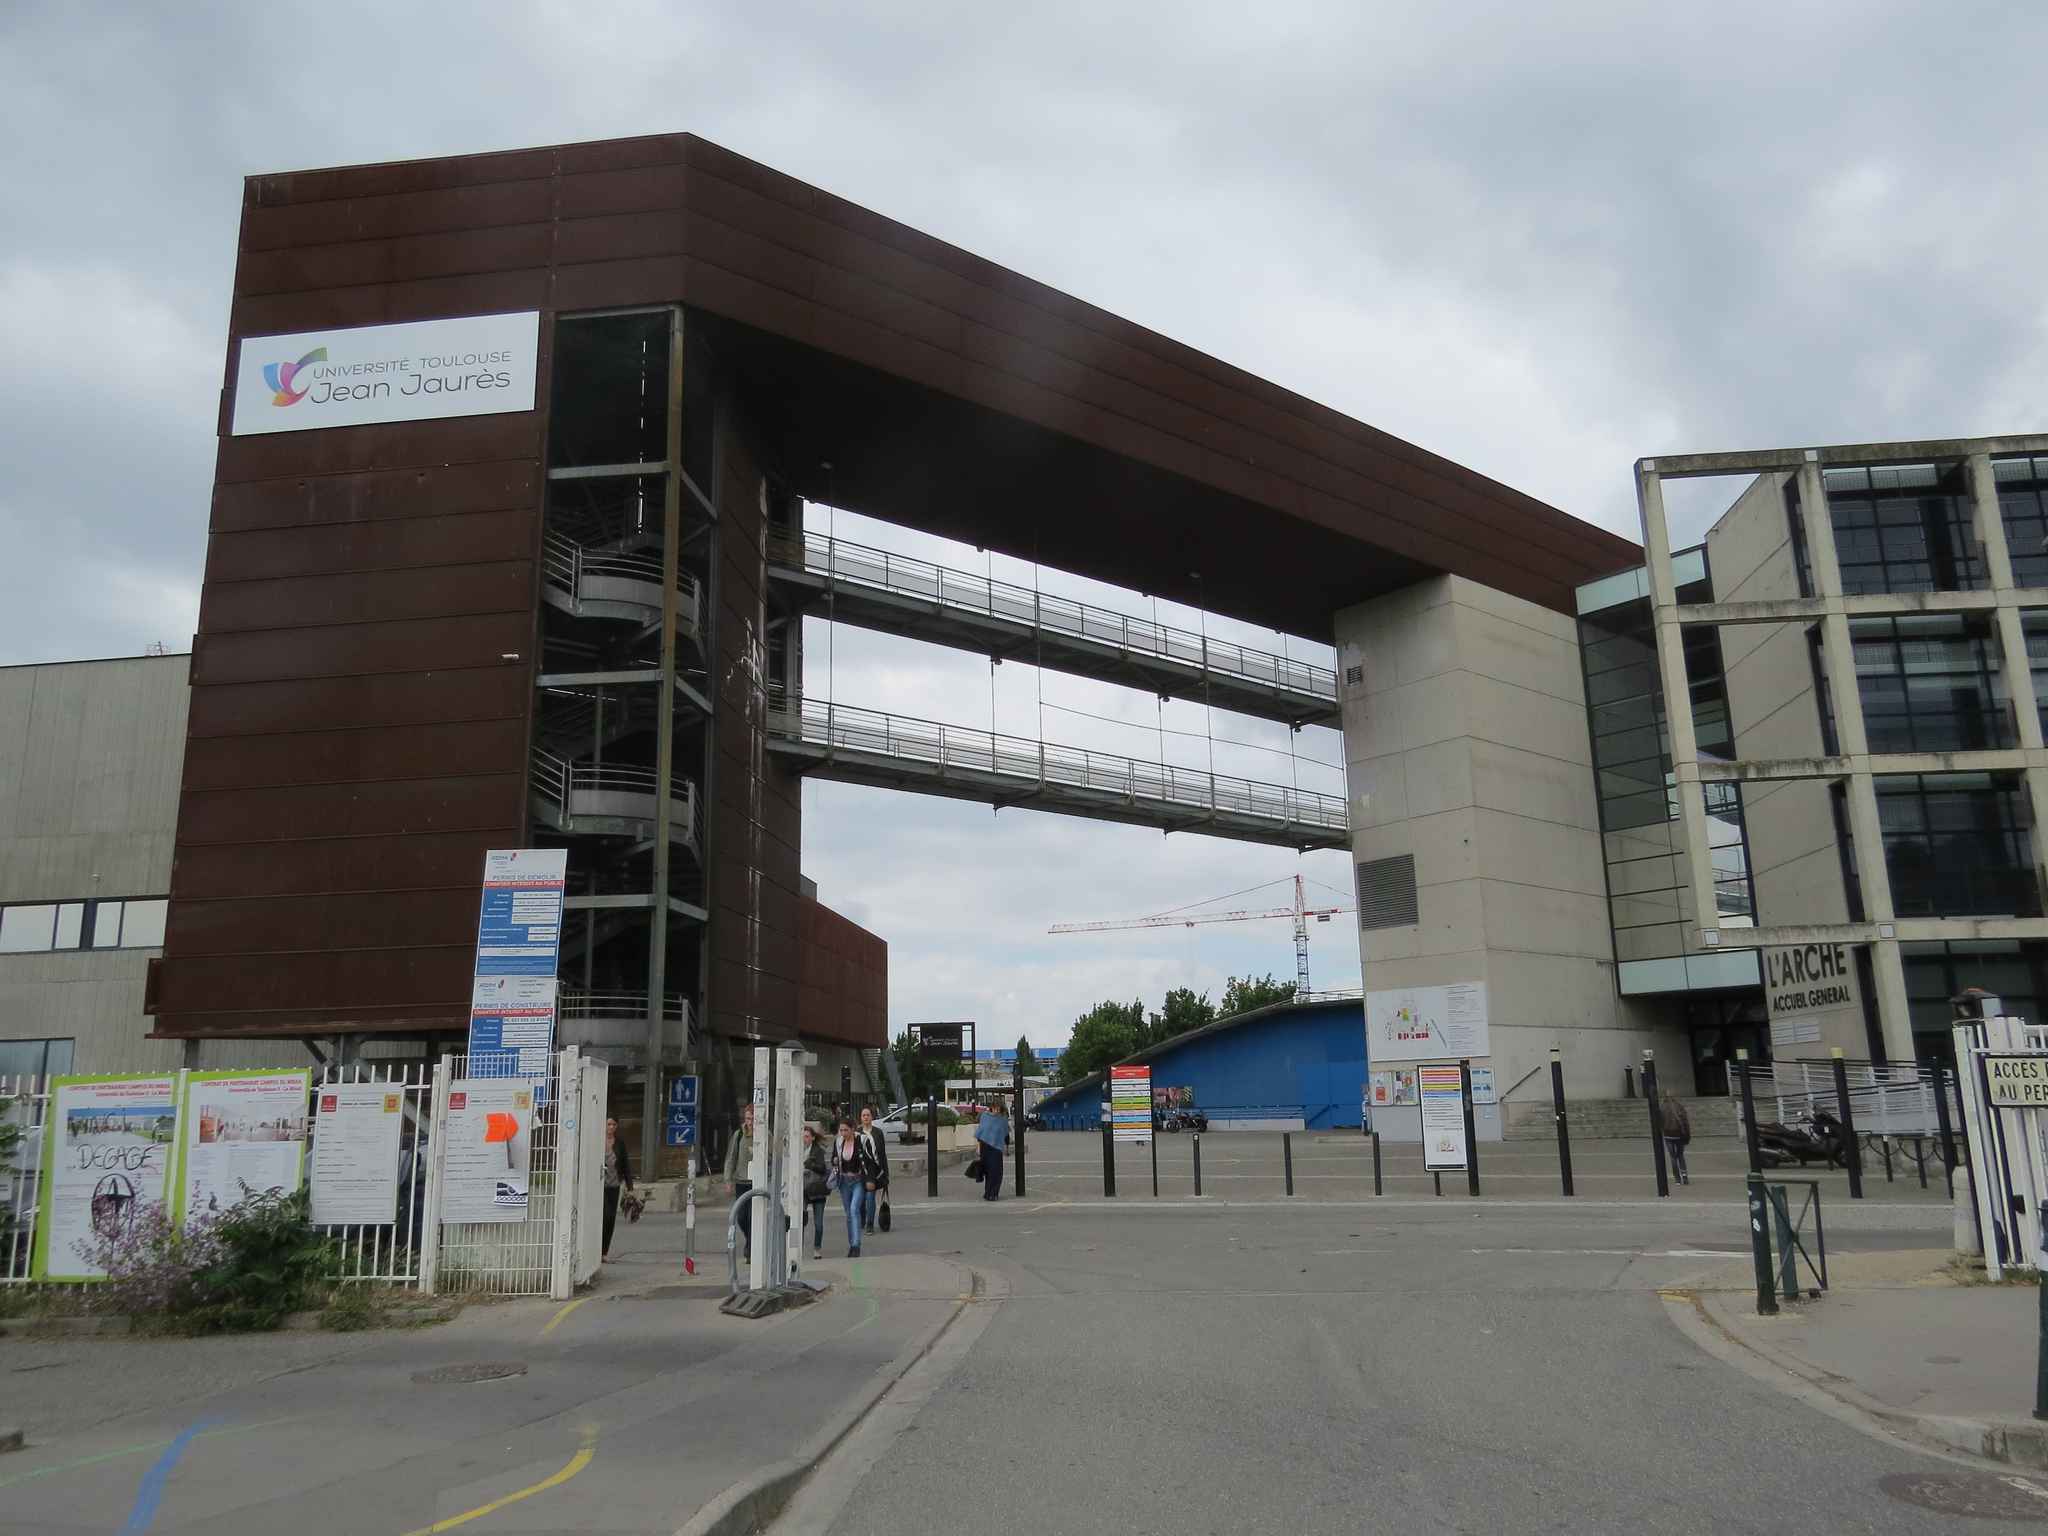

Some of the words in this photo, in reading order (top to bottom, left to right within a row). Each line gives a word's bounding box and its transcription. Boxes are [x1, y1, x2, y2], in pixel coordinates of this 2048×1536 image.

[313, 357, 410, 380] UNIVERSITÉ
[420, 351, 512, 367] TOULOUSE
[310, 379, 391, 405] Jean
[400, 368, 512, 397] Jaurès
[1768, 944, 1847, 988] L'ARCHE
[1773, 991, 1808, 1012] ACCUEIL
[2000, 1084, 2017, 1100] AU
